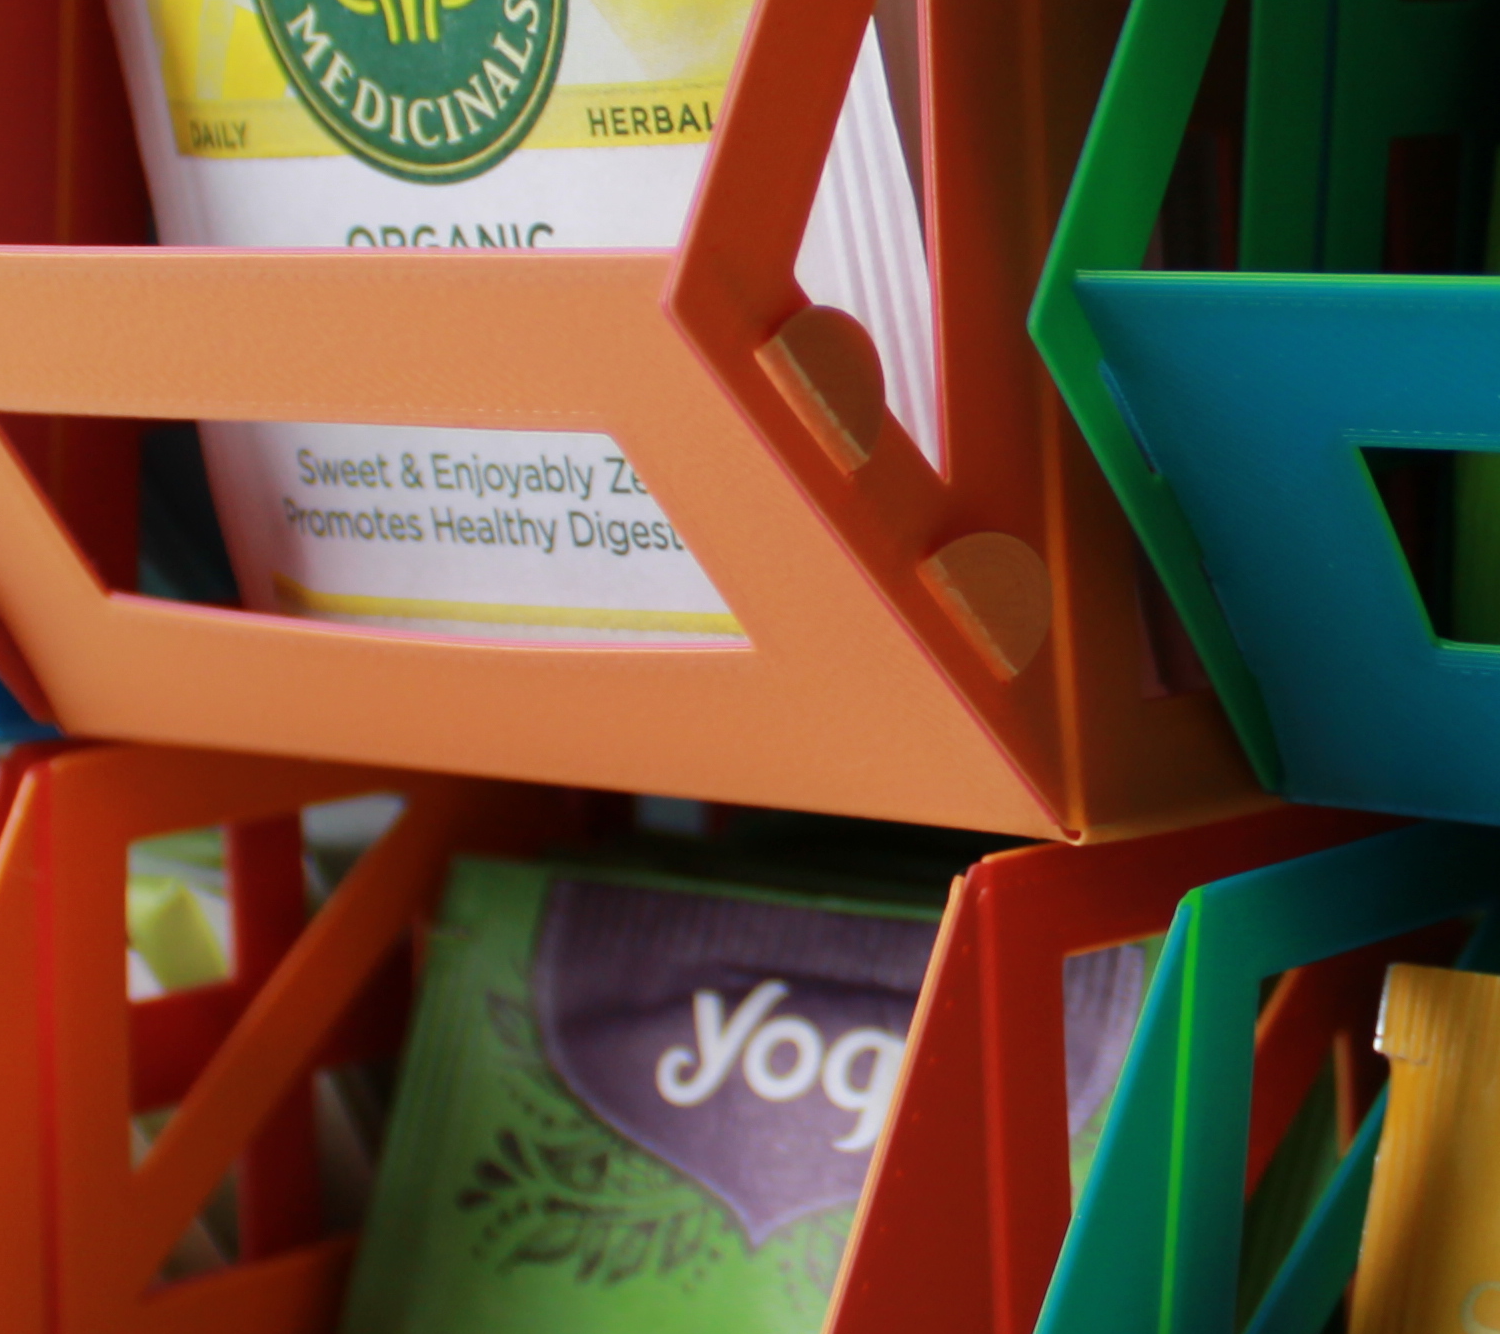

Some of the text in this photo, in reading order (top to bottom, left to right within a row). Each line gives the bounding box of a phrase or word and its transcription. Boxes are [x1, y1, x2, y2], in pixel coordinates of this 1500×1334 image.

[190, 121, 248, 149] DAILY
[586, 101, 714, 137] HERBAL
[296, 448, 392, 489] Sweet
[400, 452, 424, 487] &
[432, 452, 594, 500] Enjoyably
[285, 500, 424, 543] Promotes
[433, 505, 562, 553] Healthy
